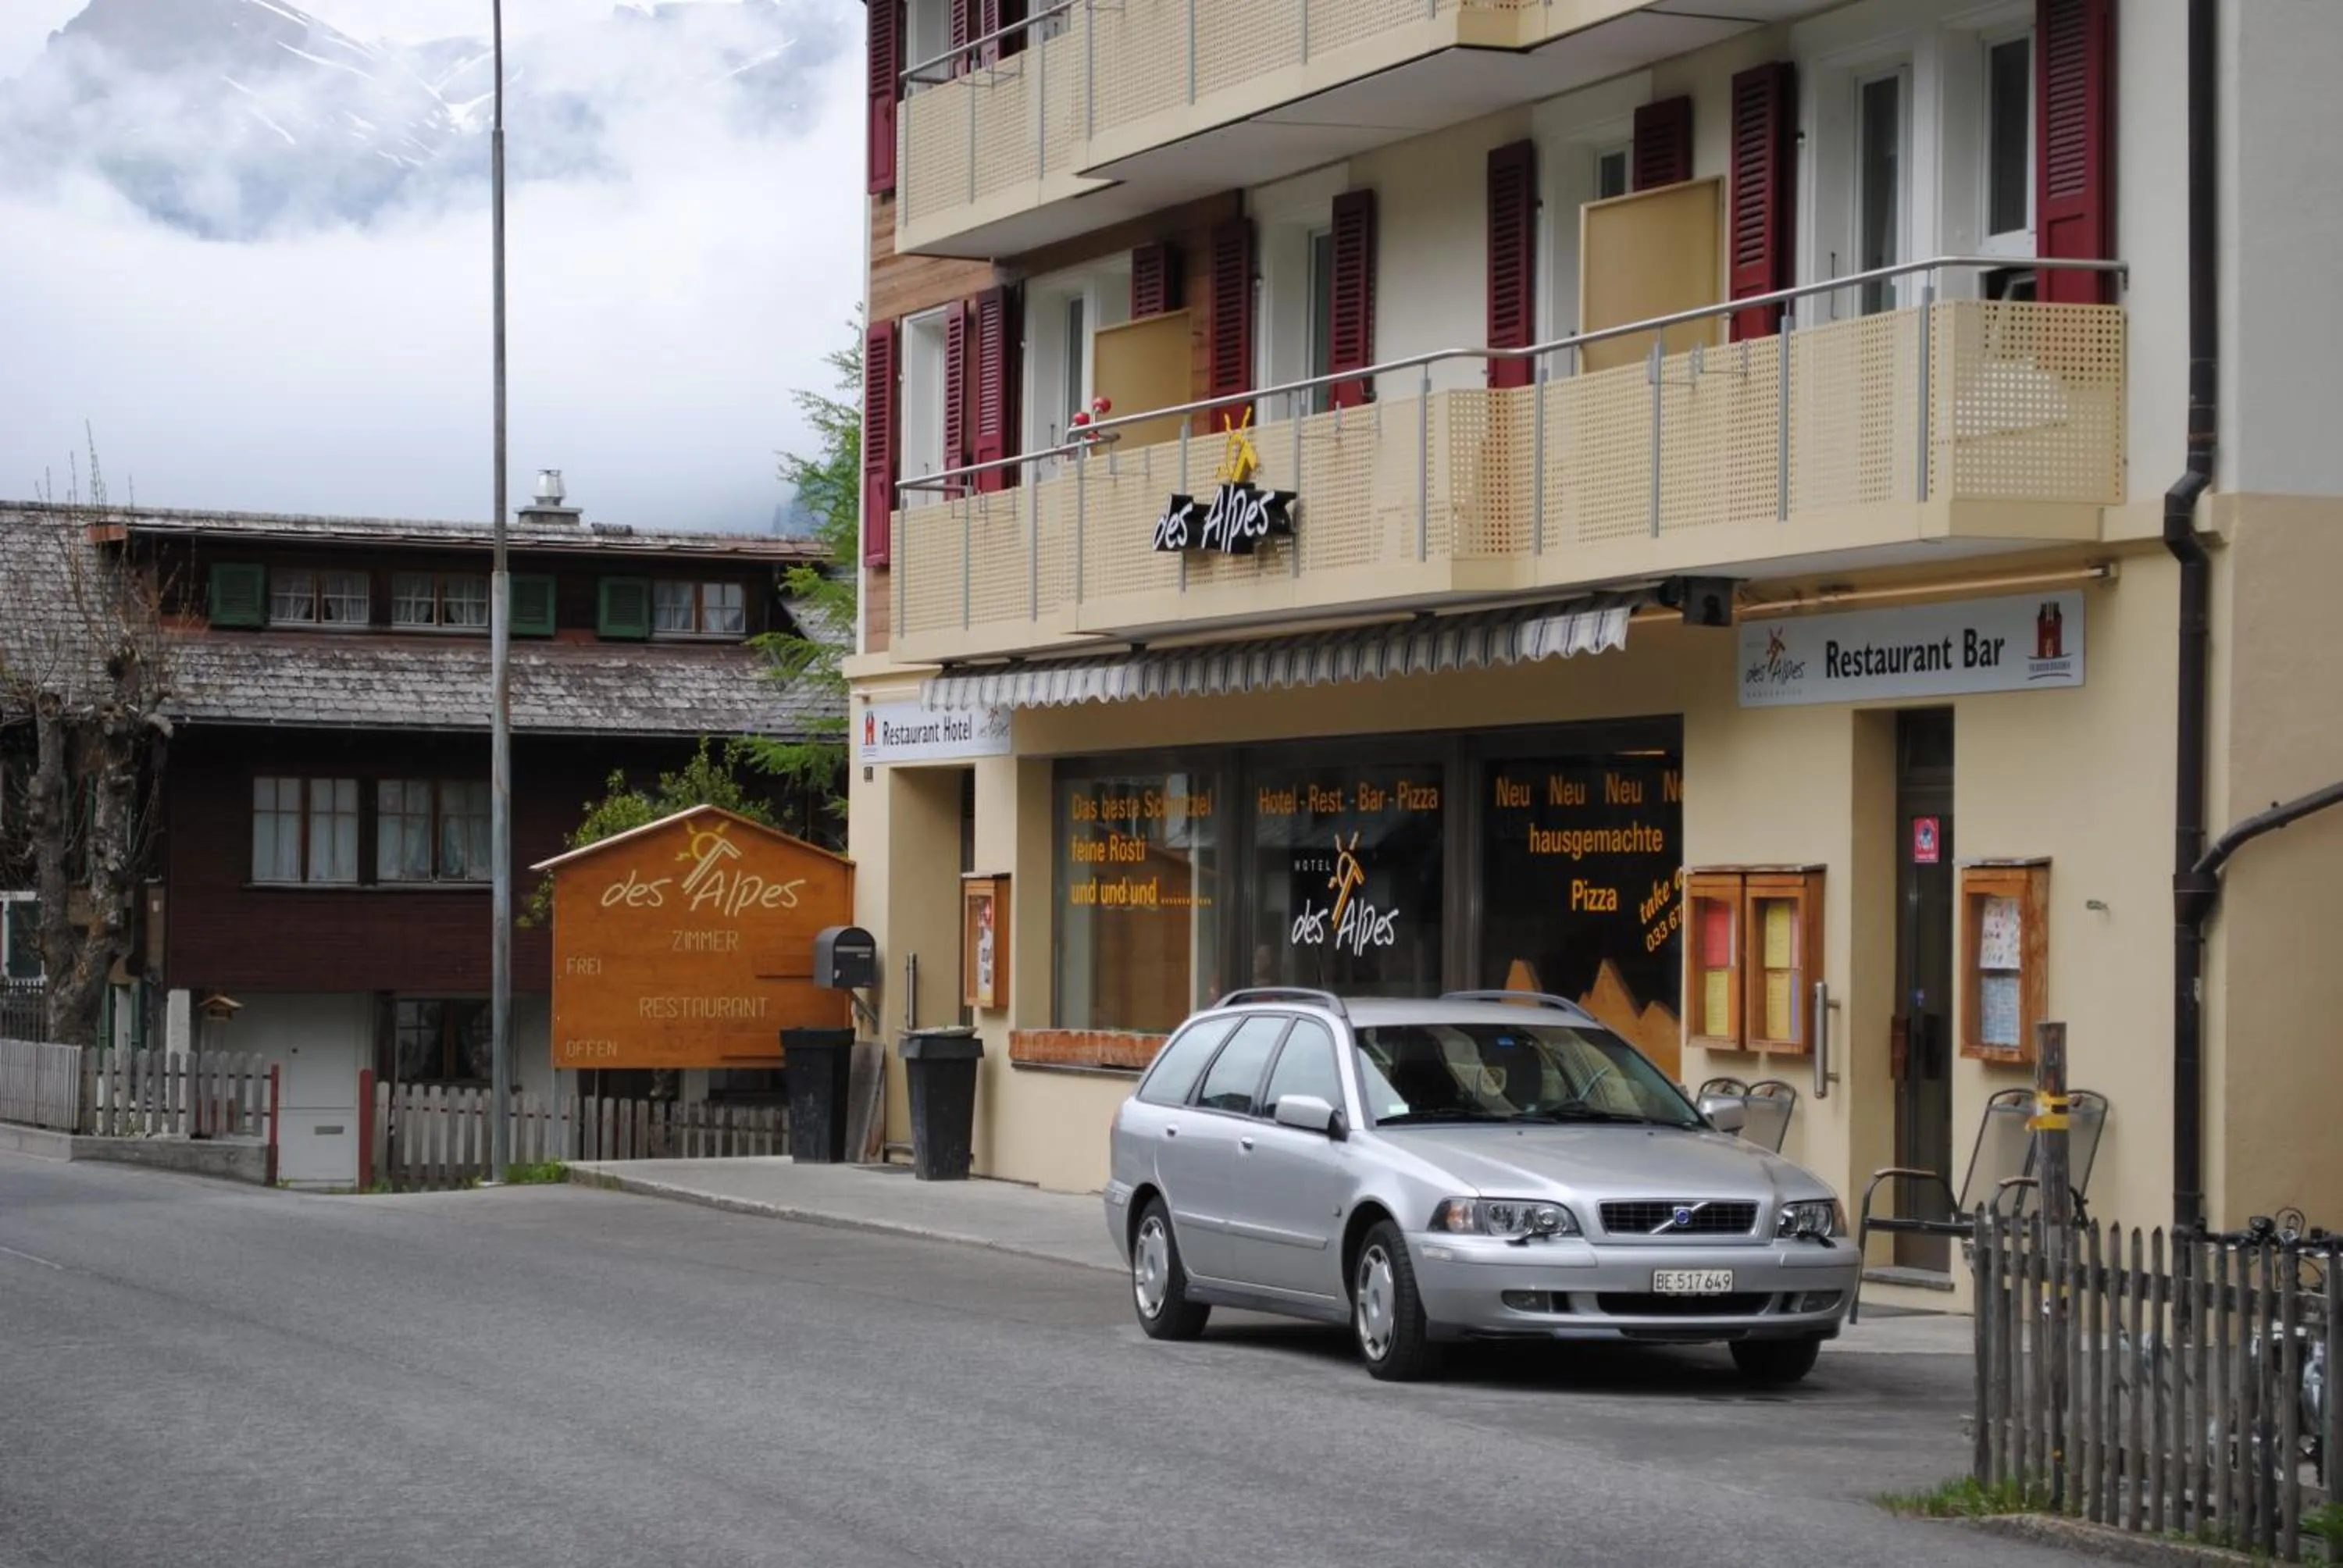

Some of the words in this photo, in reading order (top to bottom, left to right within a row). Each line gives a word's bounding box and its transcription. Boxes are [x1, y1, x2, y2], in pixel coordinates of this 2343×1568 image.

[1152, 494, 1193, 551] des
[1201, 483, 1275, 554] Alpes
[1825, 634, 1952, 679] Restaurant
[1963, 628, 2005, 669] Bar
[883, 721, 940, 747] Restaurant
[943, 714, 972, 742] Hotel
[1072, 793, 1097, 819] Das
[1102, 789, 1139, 819] beste
[1144, 787, 1213, 818] Schnitzel
[1259, 786, 1296, 814] Hotel
[1358, 782, 1385, 811] Bar
[1397, 782, 1439, 811] Pizza
[1496, 776, 1531, 807] Neu
[1550, 775, 1585, 806] Neu
[1605, 772, 1642, 804] Neu
[1529, 821, 1663, 861] hausgemachte
[1294, 860, 1331, 871] HOTEL
[601, 868, 673, 907] des
[690, 869, 806, 917] Alpes
[1072, 877, 1097, 904] und
[1100, 876, 1126, 904] und
[1571, 879, 1617, 911] Pizza
[1640, 880, 1670, 925] take
[672, 930, 739, 952] ZIMMER
[1291, 899, 1328, 944] des
[1336, 896, 1400, 957] Alpes
[1646, 921, 1667, 952] 033
[566, 958, 601, 976] FREI
[639, 996, 770, 1019] RESTAURANT
[566, 1040, 617, 1057] OFFEN
[1656, 1274, 1673, 1290] BE
